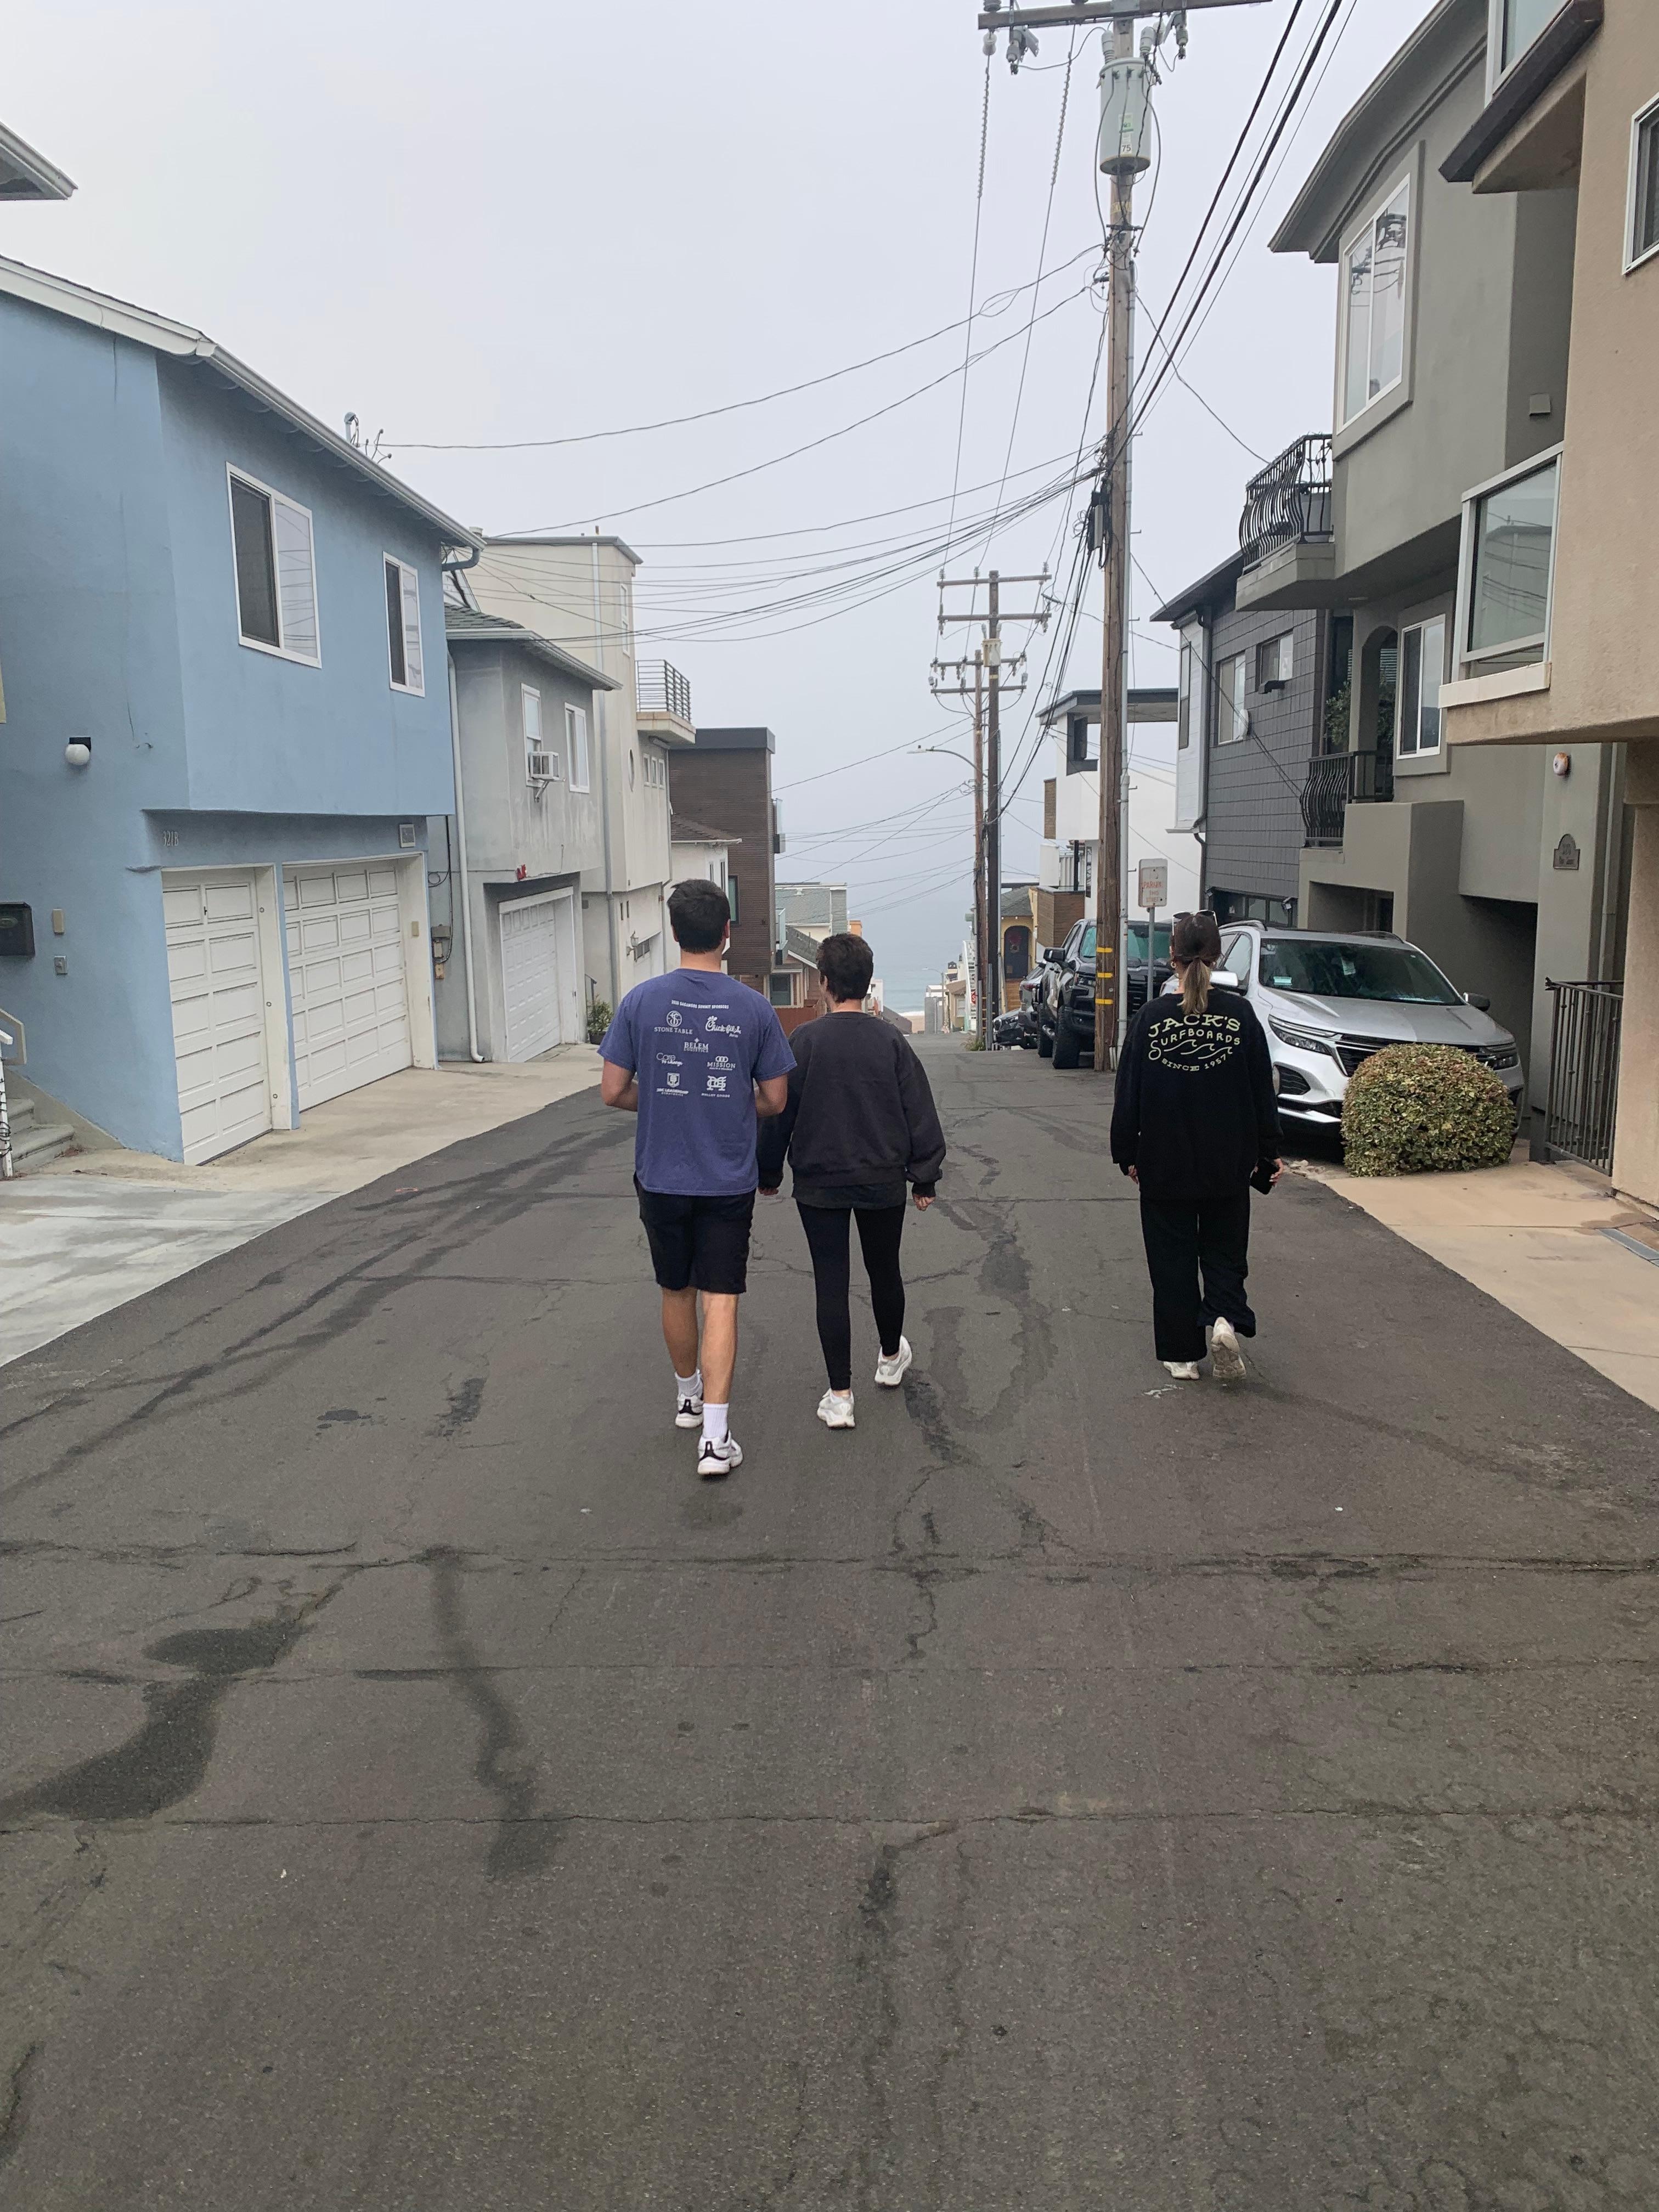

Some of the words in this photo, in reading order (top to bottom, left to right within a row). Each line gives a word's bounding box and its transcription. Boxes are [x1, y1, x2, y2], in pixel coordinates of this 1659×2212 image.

[162, 830, 179, 847] 321B
[1148, 1014, 1241, 1038] JACK'S
[1148, 1028, 1240, 1060] SURFBOARDS
[656, 1052, 676, 1061] Care
[1161, 1058, 1200, 1071] SINCE
[1204, 1053, 1226, 1069] 1957
